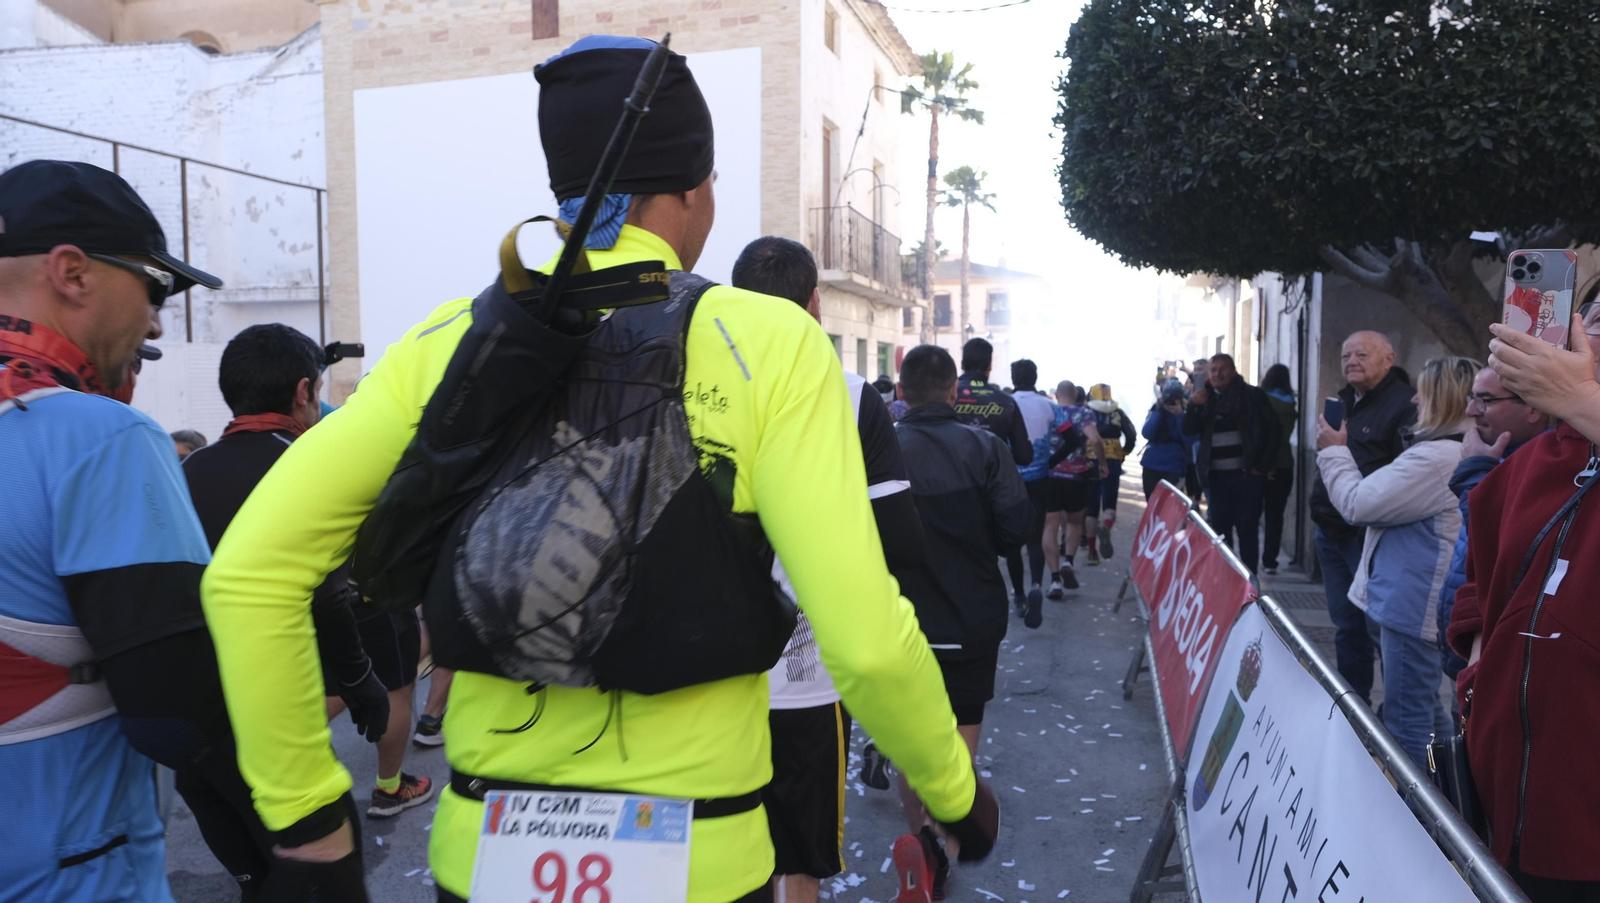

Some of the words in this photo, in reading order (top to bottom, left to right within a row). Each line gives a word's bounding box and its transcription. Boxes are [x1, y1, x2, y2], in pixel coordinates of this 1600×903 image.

[501, 820, 520, 836] LA
[526, 818, 610, 840] PÓLVORA
[1252, 705, 1364, 903] AYUNTAMIE
[532, 851, 612, 903] 98
